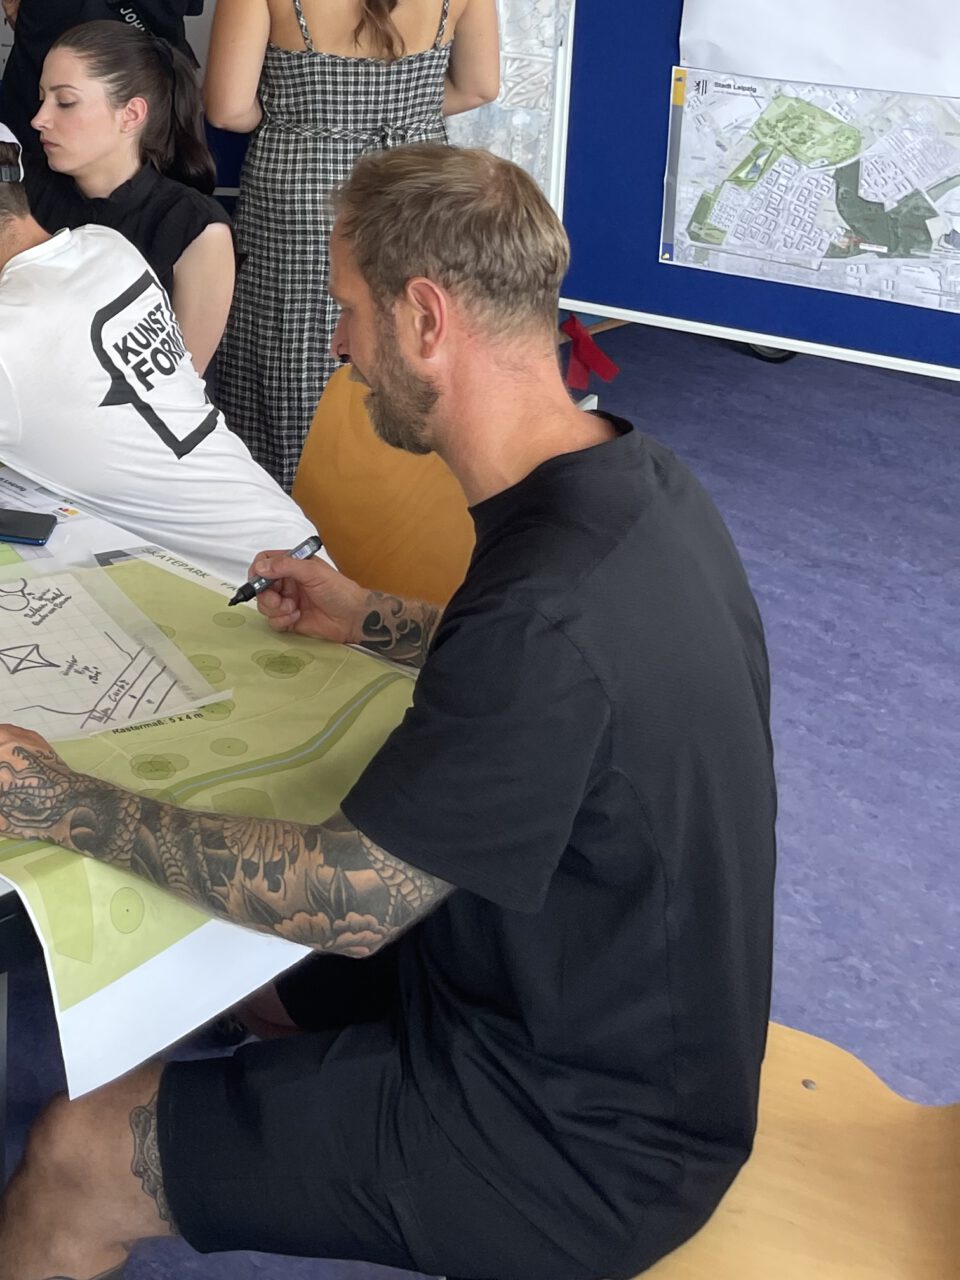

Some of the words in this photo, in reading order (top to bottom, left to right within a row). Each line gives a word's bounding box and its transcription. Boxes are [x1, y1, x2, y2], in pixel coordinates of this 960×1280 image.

[714, 81, 732, 89] Stadt
[732, 83, 757, 93] Leipzig
[112, 301, 169, 366] KUNST
[141, 547, 211, 580] SKATEPARK
